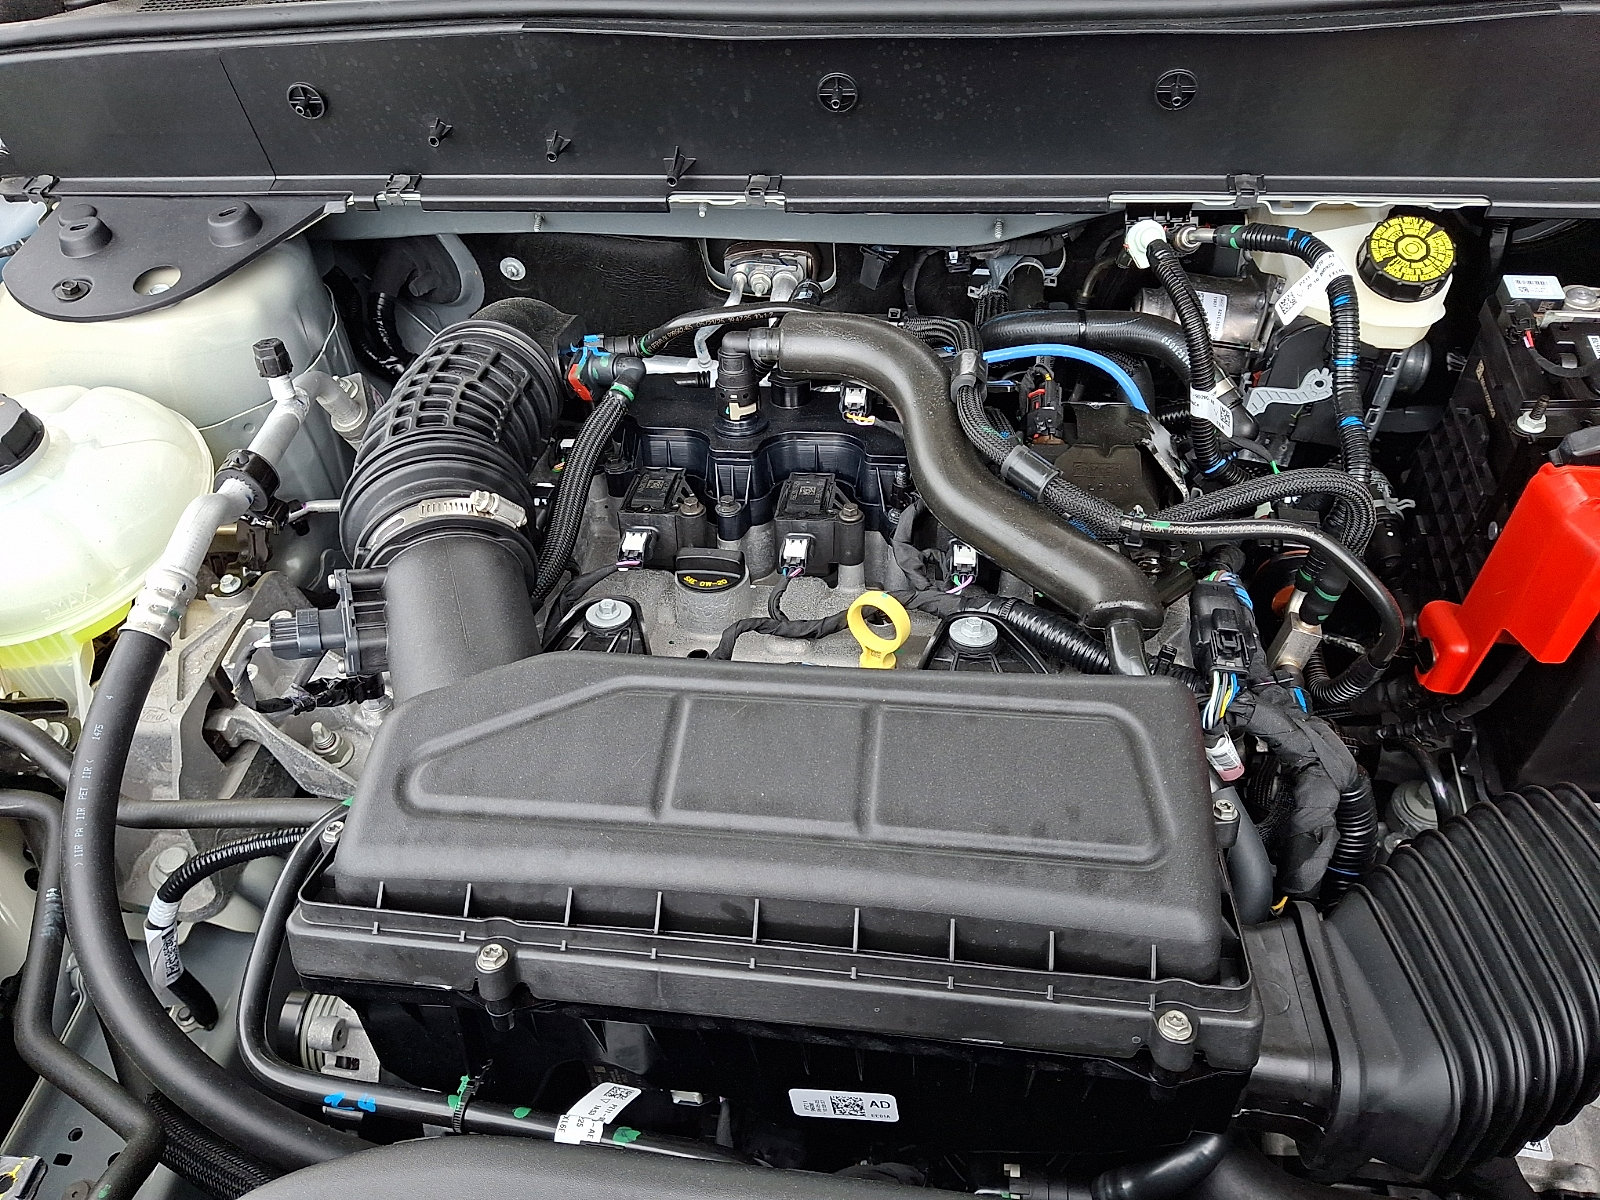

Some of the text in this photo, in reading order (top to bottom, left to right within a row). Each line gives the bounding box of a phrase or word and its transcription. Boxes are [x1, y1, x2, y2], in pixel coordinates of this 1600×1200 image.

[699, 578, 728, 587] 0W-20
[78, 787, 88, 800] PET
[92, 724, 104, 741] 1475
[869, 1100, 891, 1109] AD
